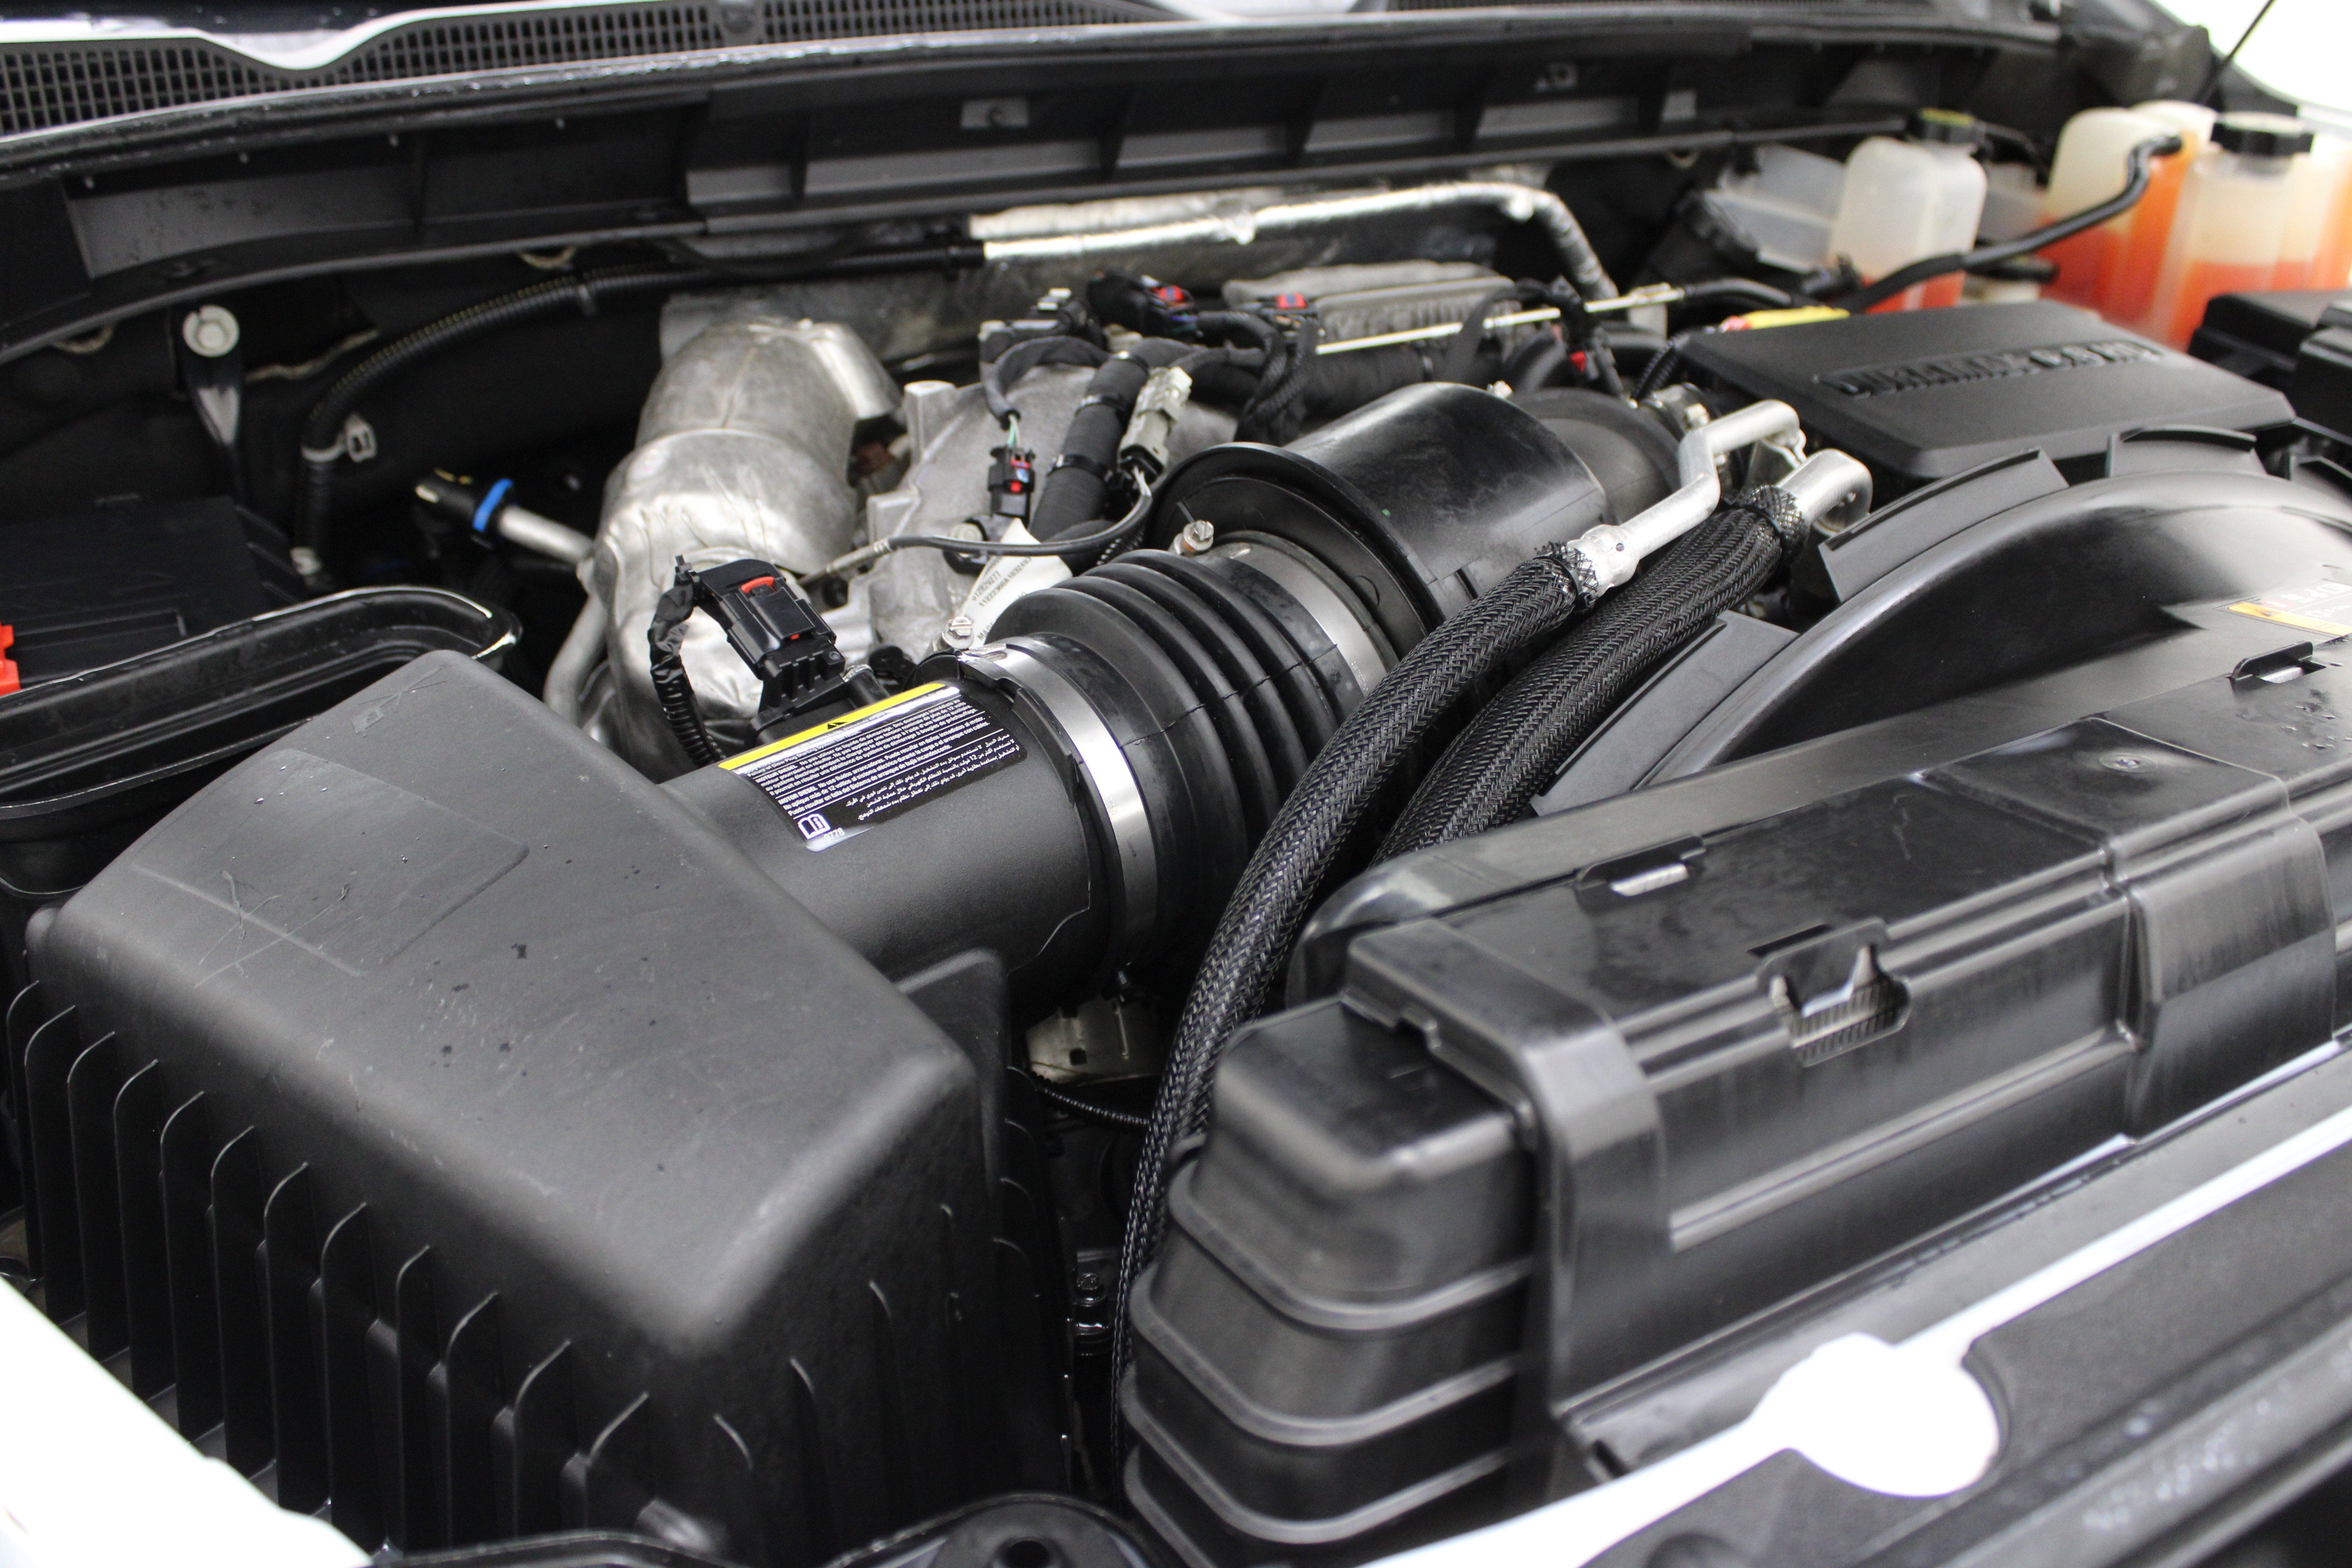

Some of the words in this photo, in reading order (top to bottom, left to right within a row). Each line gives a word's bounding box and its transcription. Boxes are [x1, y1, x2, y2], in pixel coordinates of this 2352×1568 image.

[746, 767, 766, 777] Failure
[794, 747, 818, 757] Starting
[755, 771, 779, 783] MOTEUR
[777, 764, 798, 774] DIESEL
[817, 749, 835, 758] utiliser
[841, 739, 860, 748] liquide
[865, 726, 894, 739] démarrage.
[902, 711, 930, 724] dommages
[928, 702, 954, 713] immédiats
[760, 777, 779, 787] moteur
[779, 766, 806, 780] pourraient
[812, 755, 834, 766] résulter.
[850, 739, 874, 751] appliquer
[882, 727, 902, 737] tension
[901, 719, 924, 730] nominale
[772, 777, 795, 788] système
[794, 766, 820, 780] électrique
[819, 758, 841, 770] pendant
[845, 749, 864, 758] charge
[875, 733, 902, 746] démarrage
[904, 726, 920, 734] l'aide
[918, 720, 933, 728] d'une
[931, 713, 951, 722] batterie
[950, 705, 973, 716] auxiliaire.
[773, 783, 795, 795] pourrait
[800, 773, 820, 783] résulter
[829, 758, 856, 771] défaillance
[862, 746, 884, 757] système
[889, 733, 917, 746] démarrage
[919, 723, 940, 734] bougies
[945, 708, 978, 724] préchauffage.
[777, 793, 799, 805] MOTOR
[797, 786, 818, 797] DIESEL
[834, 771, 853, 781] fluidos
[852, 758, 886, 774] arrancadores.
[884, 751, 901, 760] Puede
[899, 743, 919, 754] resultar
[924, 735, 940, 744] daños
[938, 724, 965, 737] inmediatos
[969, 716, 985, 725] motor.
[787, 806, 805, 816] Puede
[804, 797, 824, 809] resultar
[849, 778, 871, 790] Sistema
[877, 766, 900, 778] arranque
[904, 758, 918, 766] bujía
[915, 744, 952, 761] incandescente.
[791, 796, 810, 807] aplique
[808, 791, 822, 800] más
[834, 779, 852, 788] voltios
[856, 768, 878, 780] sistema
[876, 759, 898, 771] eléctrico
[896, 752, 916, 762] durante
[920, 744, 935, 753] carga
[942, 731, 964, 743] arranque
[972, 721, 990, 731] cables.
